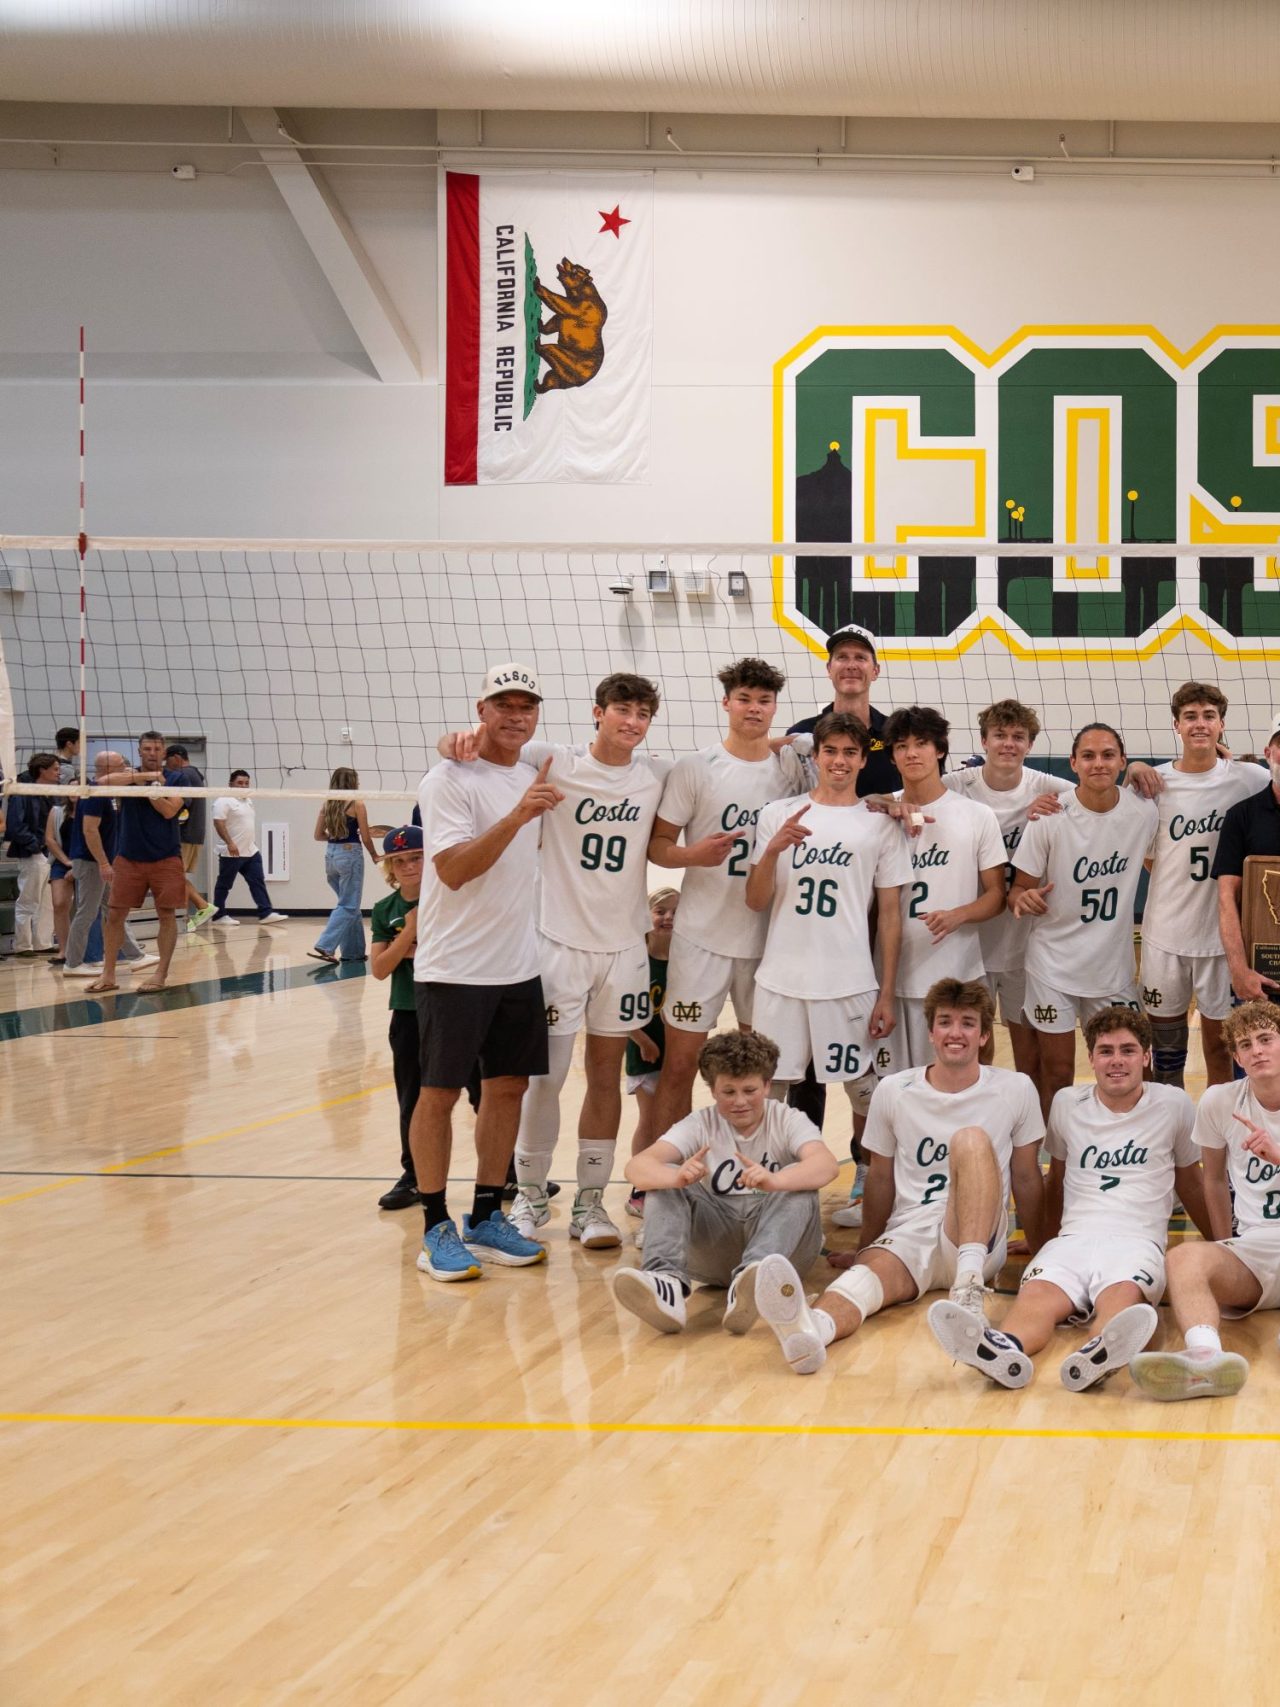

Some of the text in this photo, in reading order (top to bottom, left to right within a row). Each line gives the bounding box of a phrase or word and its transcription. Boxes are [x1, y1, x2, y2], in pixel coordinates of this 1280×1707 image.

[494, 224, 516, 432] CALIFORNIA REPUBLIC
[494, 671, 536, 690] COSTA
[575, 797, 641, 825] Costa
[721, 803, 765, 831] Cos
[1169, 809, 1226, 841] Costa
[580, 833, 627, 873] 99
[792, 842, 853, 869] Costa
[912, 843, 950, 870] osta
[1073, 851, 1130, 883] Costa
[1190, 846, 1209, 882] 5
[795, 876, 839, 918] 36
[909, 881, 929, 918] 2
[1081, 887, 1118, 923] 50
[619, 991, 650, 1021] 99
[825, 1043, 861, 1074] 36
[1080, 1139, 1149, 1169] Costa
